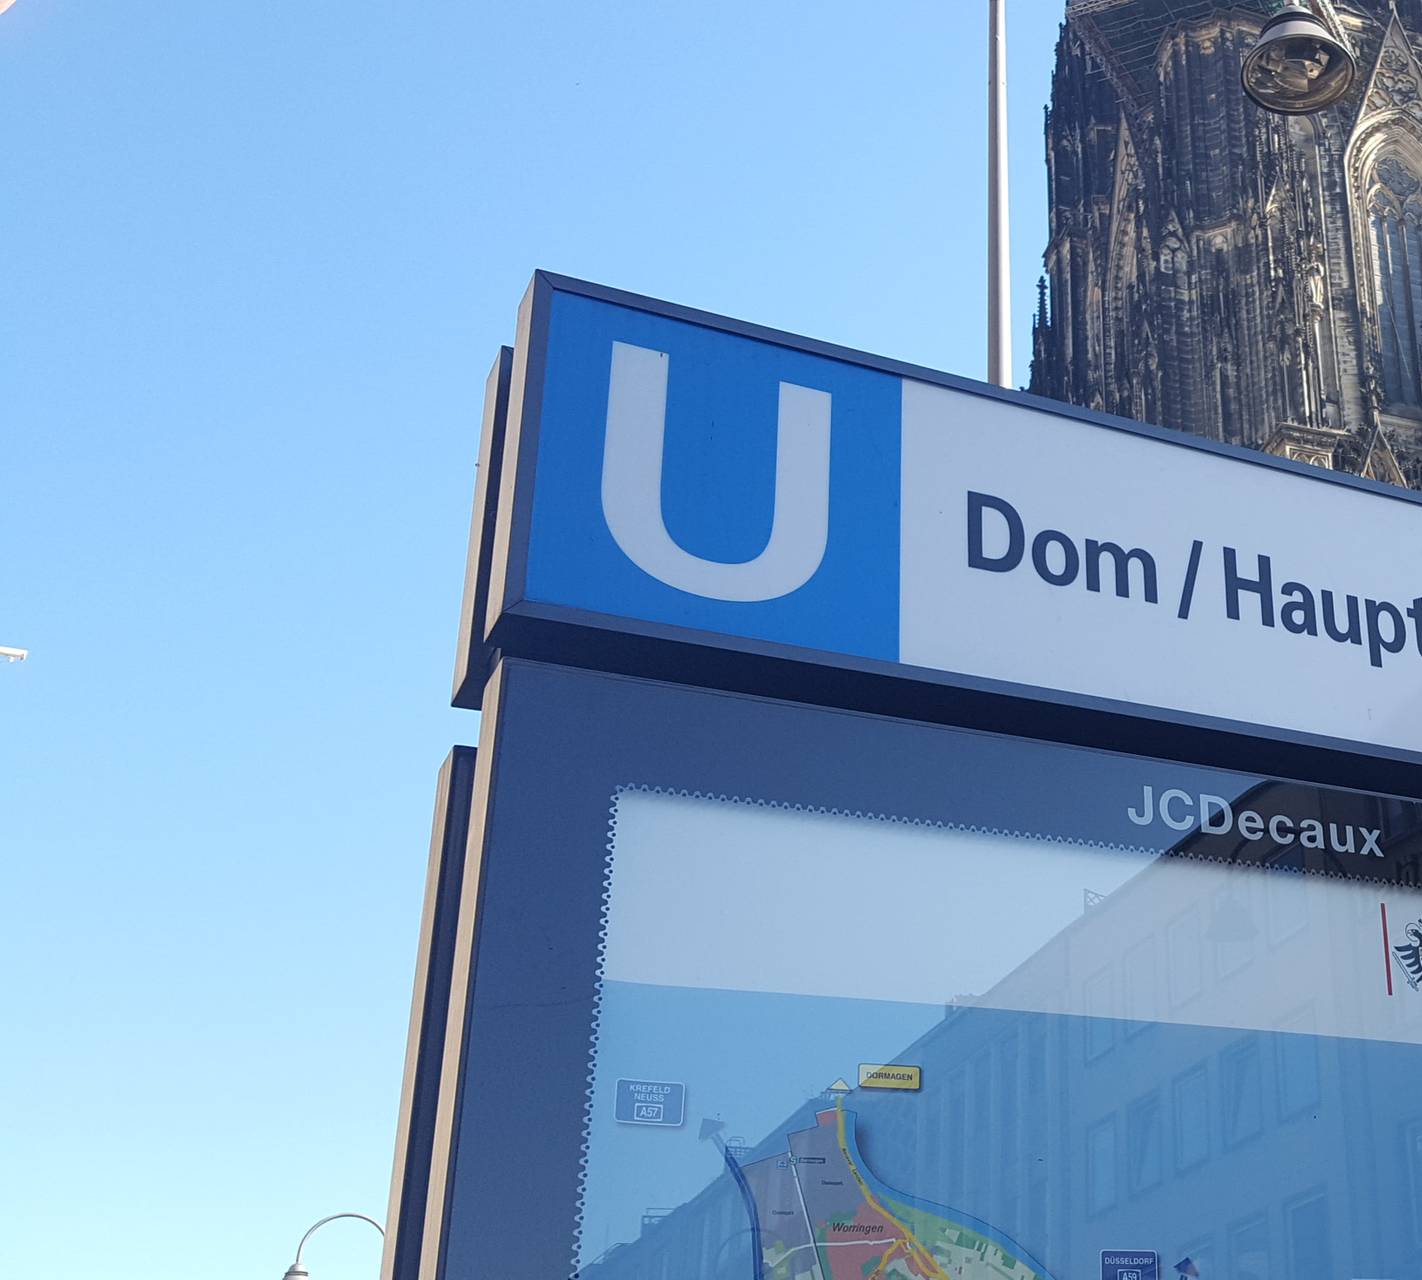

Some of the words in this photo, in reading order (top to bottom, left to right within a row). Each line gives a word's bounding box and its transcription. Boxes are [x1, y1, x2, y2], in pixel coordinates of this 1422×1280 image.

[601, 341, 833, 602] U
[966, 490, 1158, 606] Dom
[1127, 785, 1385, 858] JCDecaux
[866, 1071, 913, 1081] DORMAGEN
[630, 1084, 671, 1094] KREFELD
[634, 1093, 664, 1102] NEUSS
[639, 1106, 658, 1118] A57
[832, 1222, 884, 1235] Worringen
[1104, 1256, 1154, 1265] DÜSSELDORF
[1122, 1271, 1138, 1280] A59
